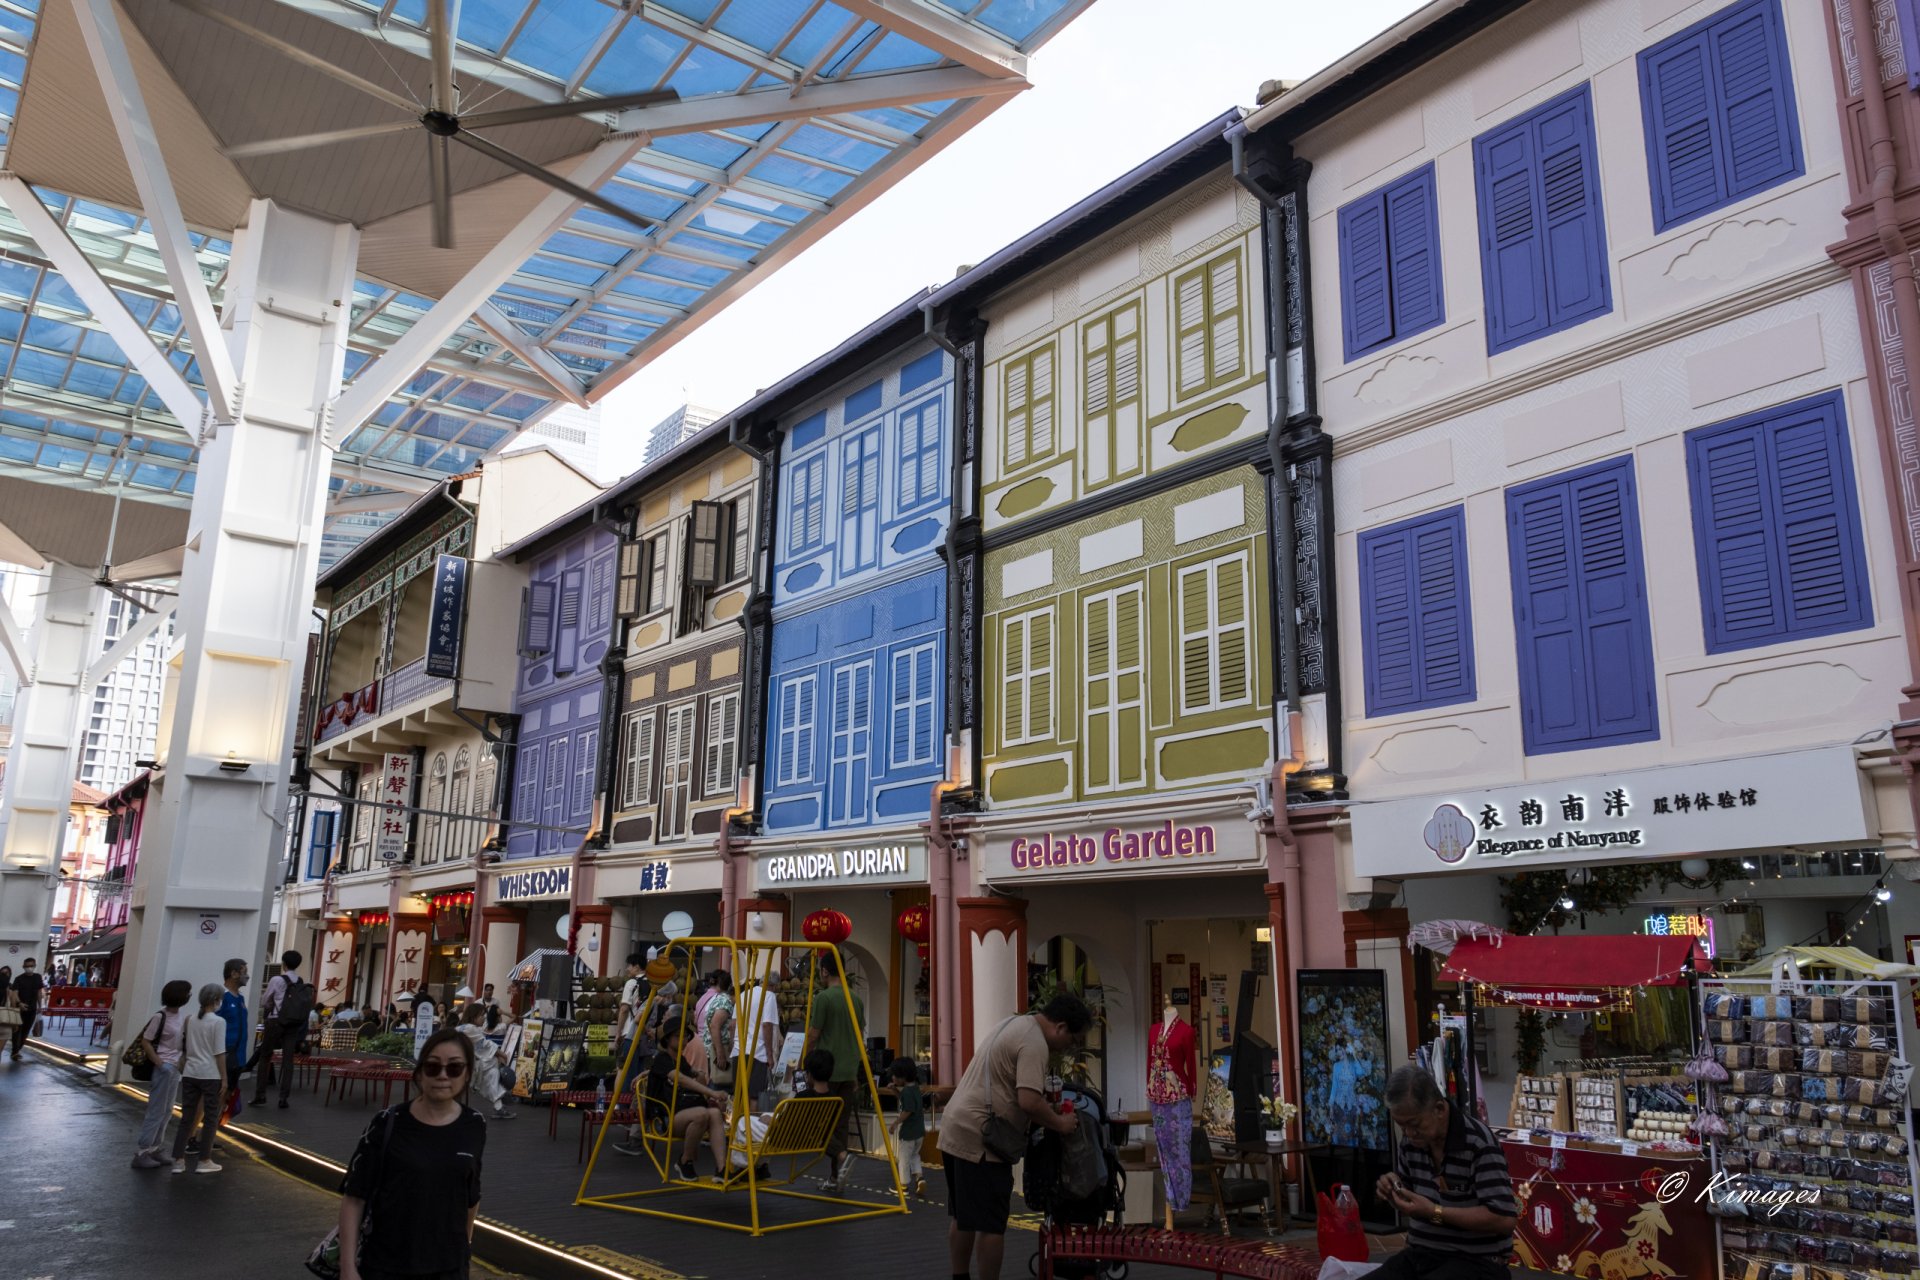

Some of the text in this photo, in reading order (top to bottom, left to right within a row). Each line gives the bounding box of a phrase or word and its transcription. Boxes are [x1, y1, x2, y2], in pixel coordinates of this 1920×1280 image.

[1479, 788, 1758, 830] 衣韵南洋 服饰体验馆
[1010, 819, 1215, 869] Gelato Garden
[1476, 829, 1641, 855] Elegance of Nanyang
[768, 846, 906, 880] GRANDPA DURIAN
[498, 867, 570, 899] WHISKDOM
[1545, 992, 1555, 1001] of
[1557, 992, 1598, 1003] Nanyang
